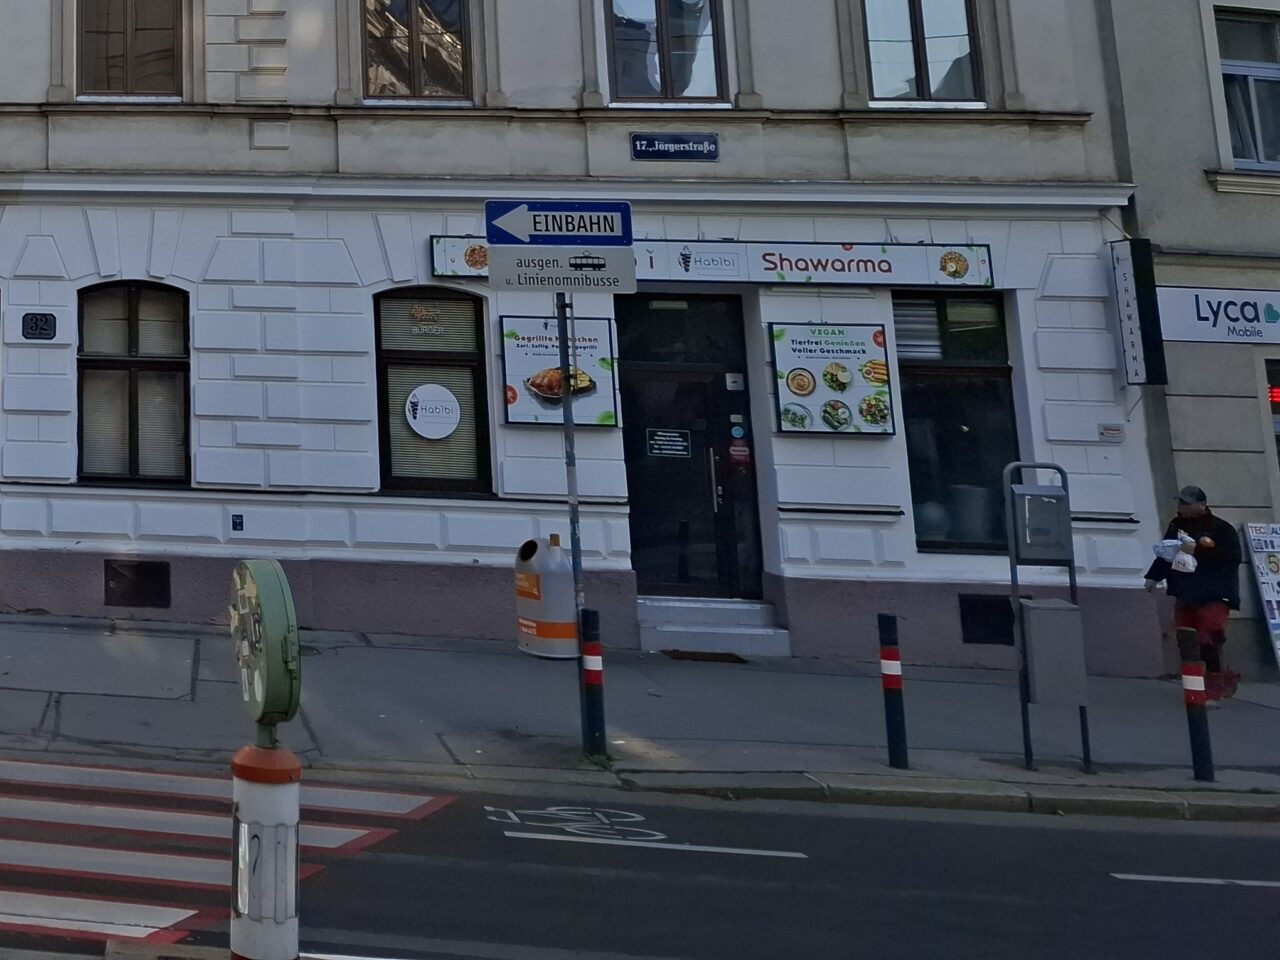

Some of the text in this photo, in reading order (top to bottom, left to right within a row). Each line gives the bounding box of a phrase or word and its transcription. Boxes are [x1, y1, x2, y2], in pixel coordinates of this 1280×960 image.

[653, 141, 716, 153] Jörgerstraße
[532, 214, 616, 233] EINBAHN
[516, 257, 563, 271] ausgen.
[761, 252, 893, 273] Shawarma
[517, 275, 620, 288] Linienomnibusse
[1194, 294, 1261, 328] Lyca
[30, 316, 49, 331] 32
[810, 328, 846, 336] VEGAN
[1227, 325, 1264, 338] Mobile
[514, 335, 553, 343] Gegrillte
